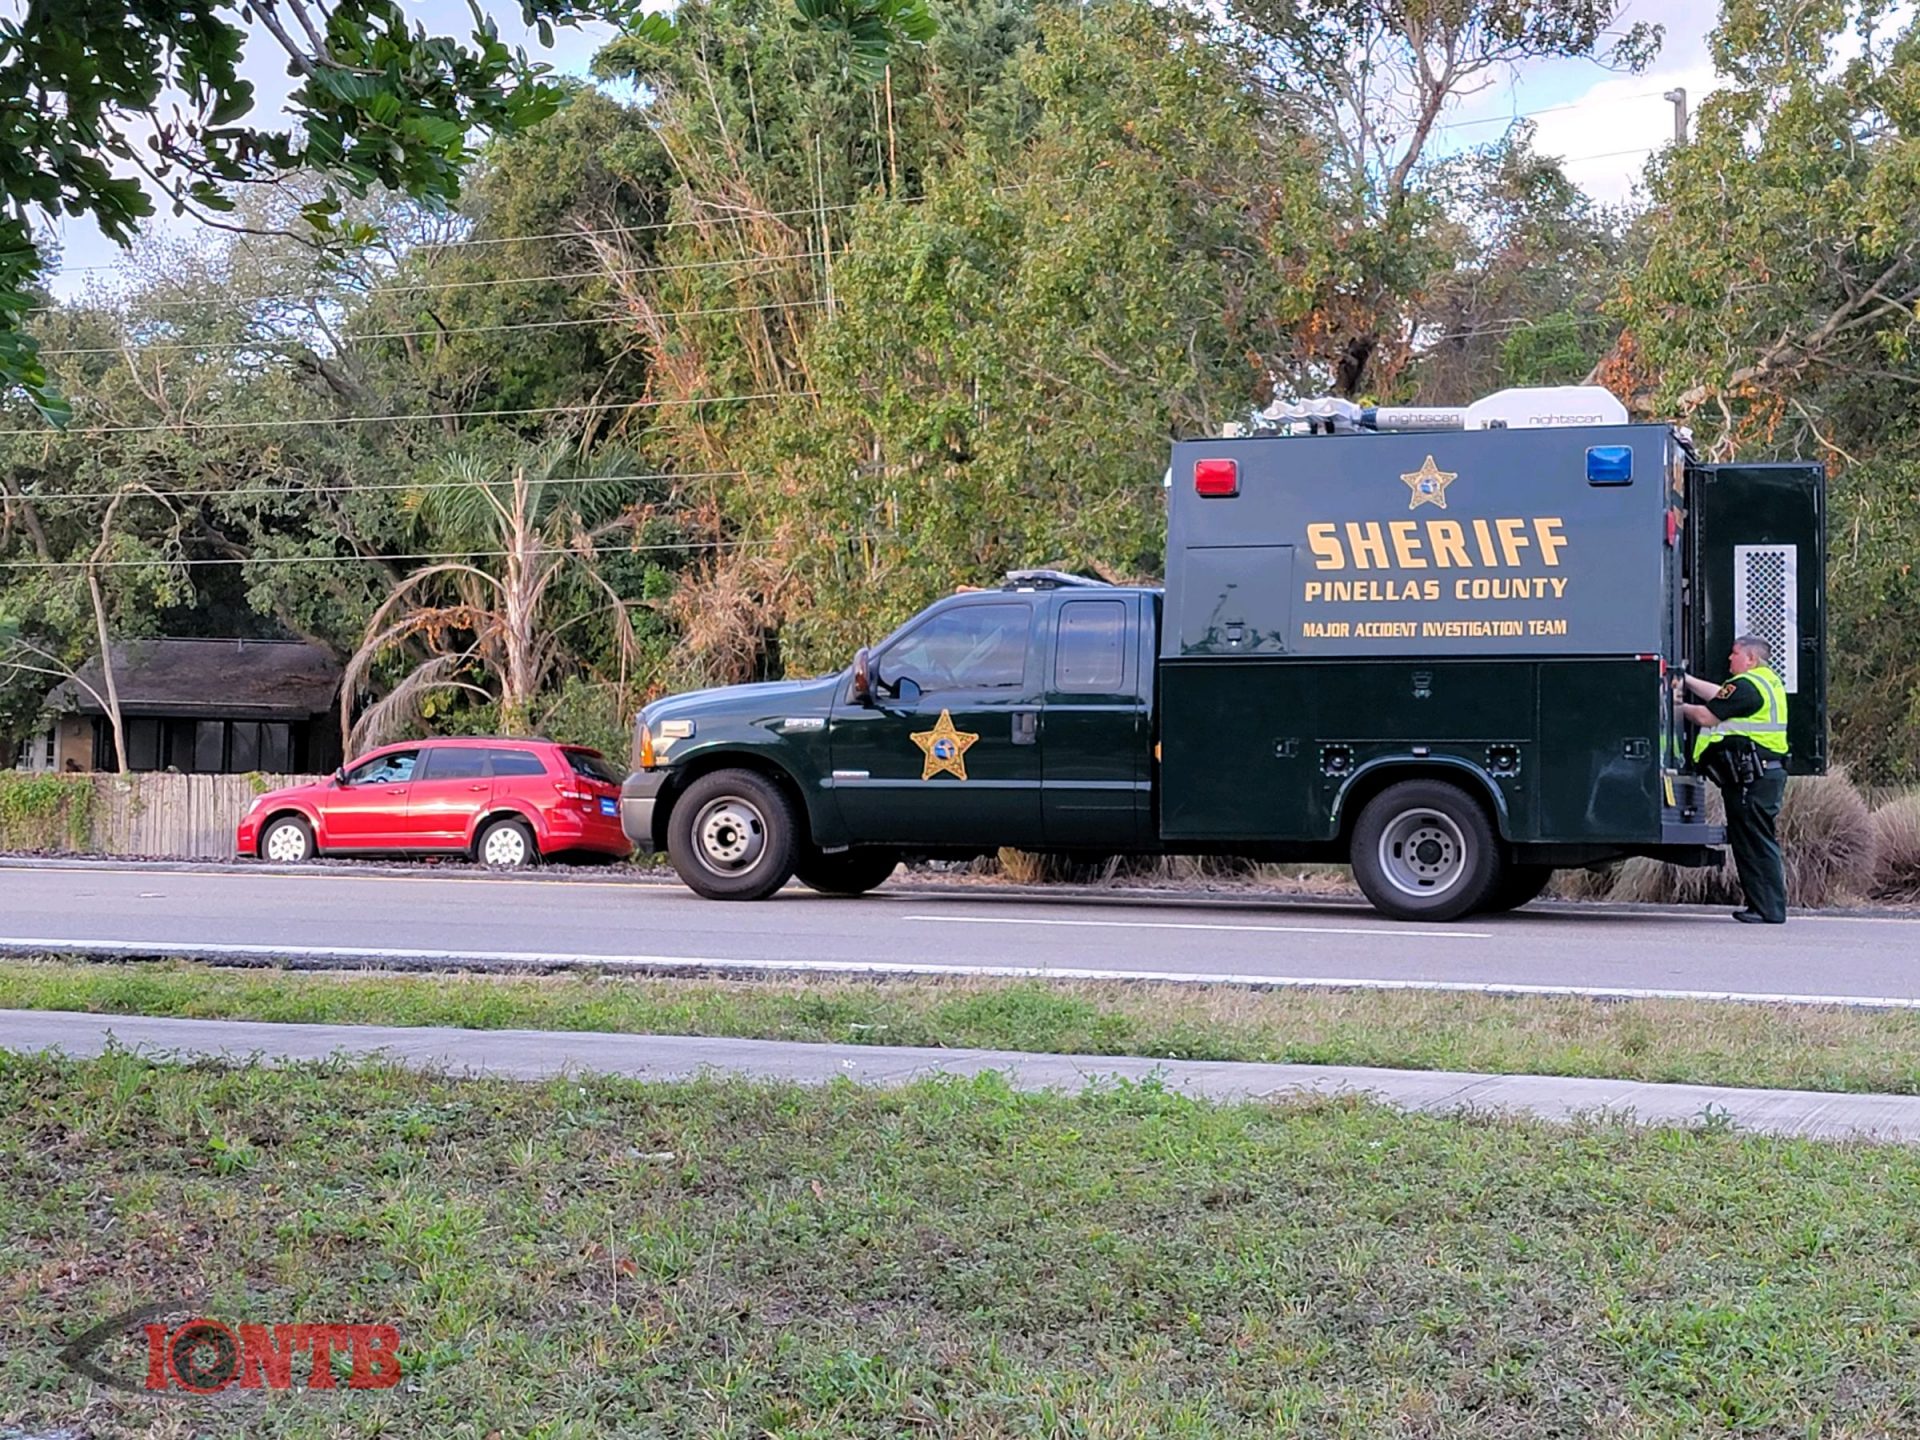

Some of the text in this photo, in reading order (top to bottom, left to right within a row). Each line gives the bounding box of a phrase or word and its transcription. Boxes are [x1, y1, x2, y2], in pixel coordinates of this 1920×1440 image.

[1388, 413, 1459, 424] nightscan
[1529, 413, 1603, 425] nightscan
[1306, 517, 1568, 570] SHERIFF
[1304, 577, 1568, 602] PINELLAS COUNTY
[1302, 619, 1567, 637] MAJOR ACCIDENT INVESTIGATION TEAM
